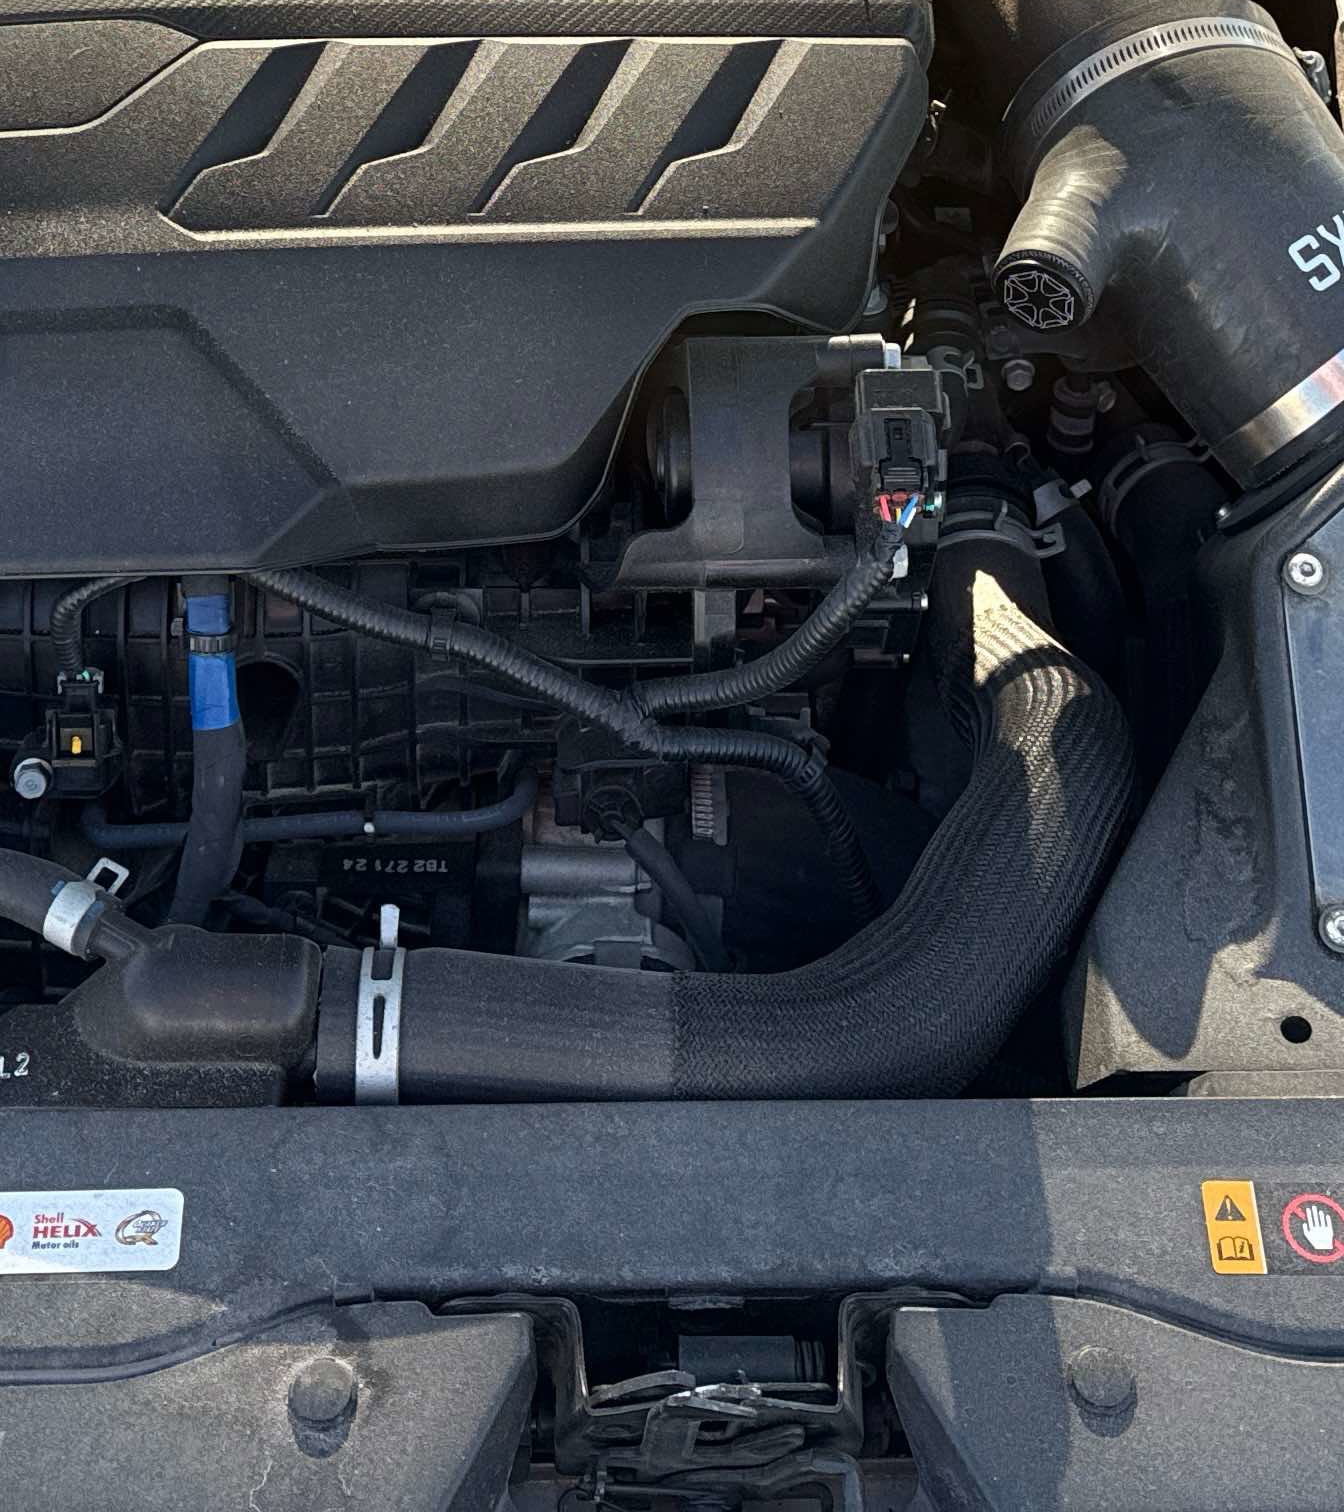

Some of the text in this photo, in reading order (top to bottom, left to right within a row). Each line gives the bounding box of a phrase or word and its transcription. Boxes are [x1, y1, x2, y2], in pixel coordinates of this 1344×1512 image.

[34, 1212, 64, 1224] Shell
[32, 1221, 99, 1239] HELIX
[31, 1240, 80, 1250] Motor oils
